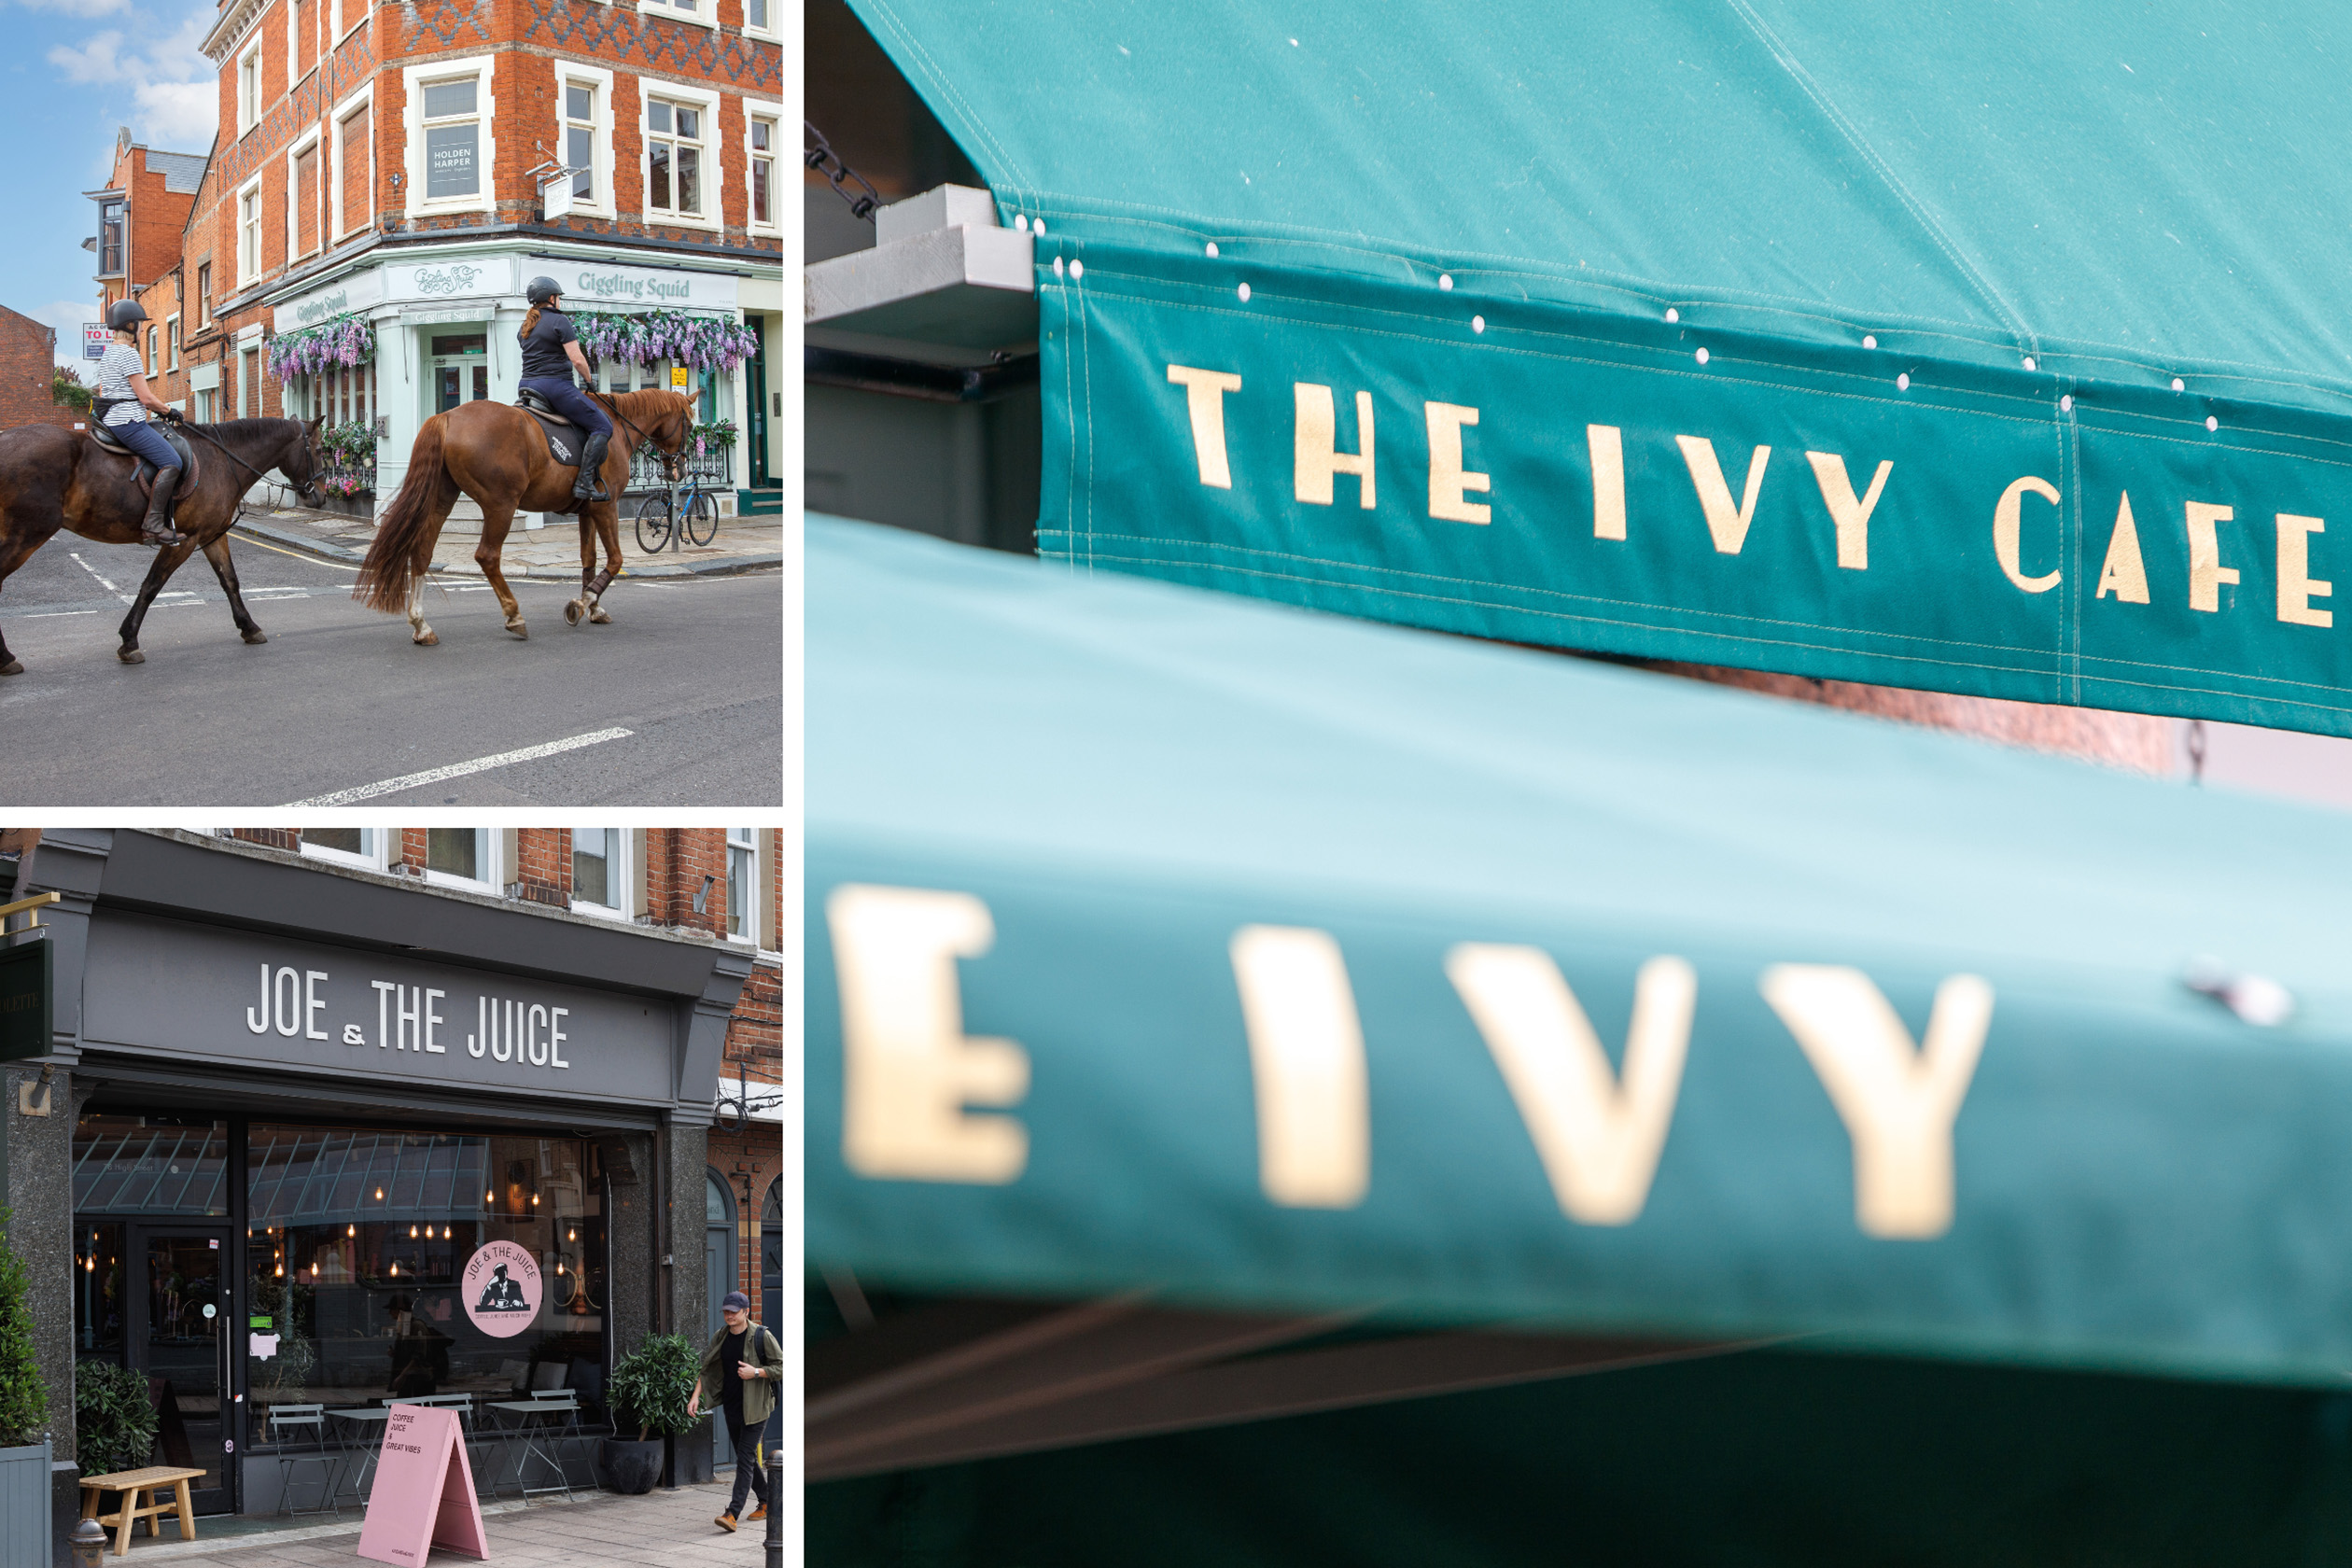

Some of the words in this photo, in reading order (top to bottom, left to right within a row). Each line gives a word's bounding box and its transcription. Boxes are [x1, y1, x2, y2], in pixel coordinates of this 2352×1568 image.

[434, 148, 471, 159] HOLDEN
[434, 158, 471, 168] HARPER
[578, 272, 644, 298] Giggling
[647, 278, 690, 300] Squid
[297, 300, 325, 322] Giggling
[325, 289, 347, 313] Squid
[415, 312, 452, 322] Giggling
[454, 310, 480, 320] Squid
[86, 330, 102, 340] TO
[1167, 363, 1492, 525] THE
[1587, 424, 1895, 569] IVY
[1992, 475, 2333, 628] CAFE
[246, 963, 329, 1040] JOE
[343, 1024, 365, 1045] &
[371, 980, 445, 1054] THE
[468, 995, 569, 1069] JUICE
[825, 881, 1033, 1186] E
[1227, 922, 1997, 1241] IVY
[114, 1163, 131, 1172] High
[468, 1257, 484, 1281] JOE
[482, 1251, 492, 1262] &
[492, 1246, 512, 1258] THE
[512, 1253, 537, 1280] JUICE
[392, 1413, 414, 1423] COFFEE
[390, 1423, 406, 1432] JUICE
[385, 1442, 404, 1451] GREAT
[404, 1445, 422, 1454] VIBES
